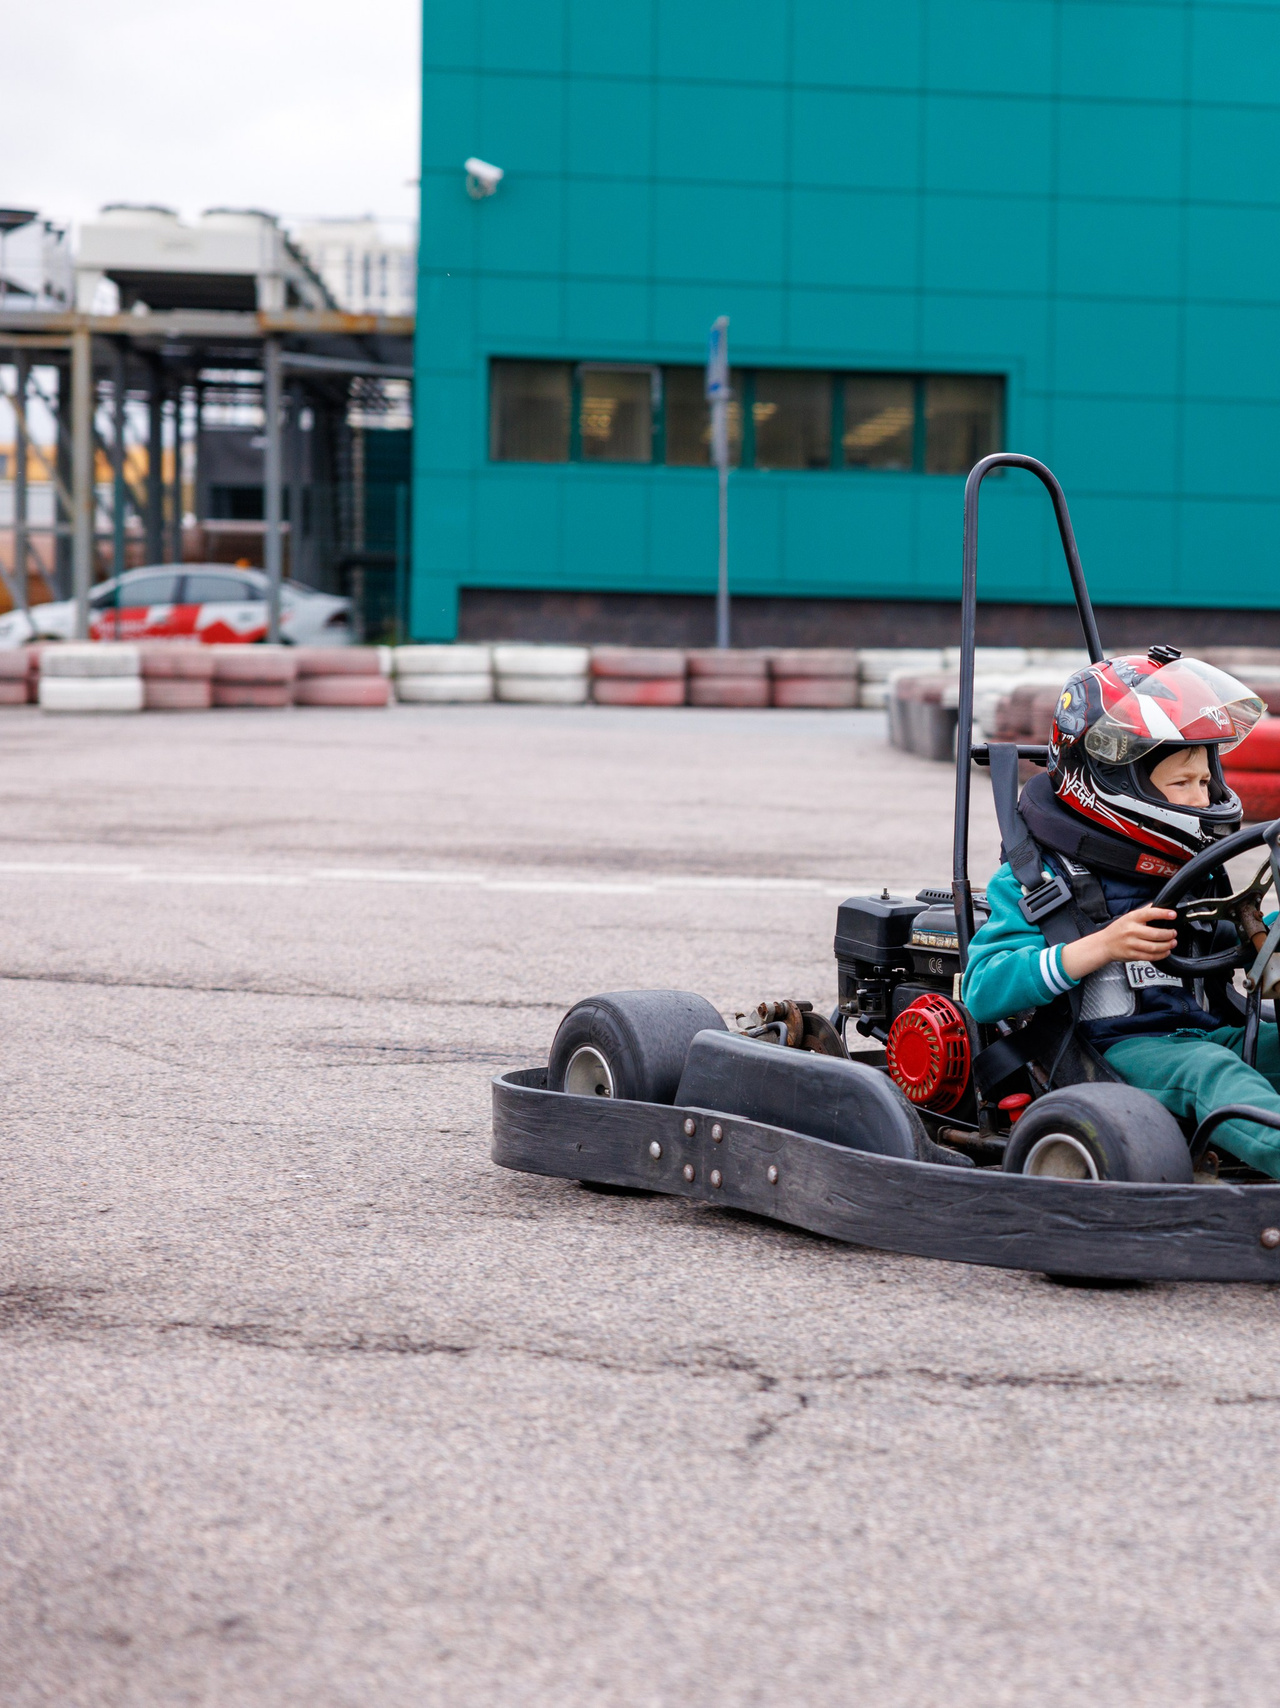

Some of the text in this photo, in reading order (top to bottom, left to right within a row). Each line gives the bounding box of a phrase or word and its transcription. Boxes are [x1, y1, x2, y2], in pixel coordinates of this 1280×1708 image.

[1060, 768, 1096, 809] VEGA
[1140, 861, 1178, 877] RLG
[929, 957, 944, 974] CE
